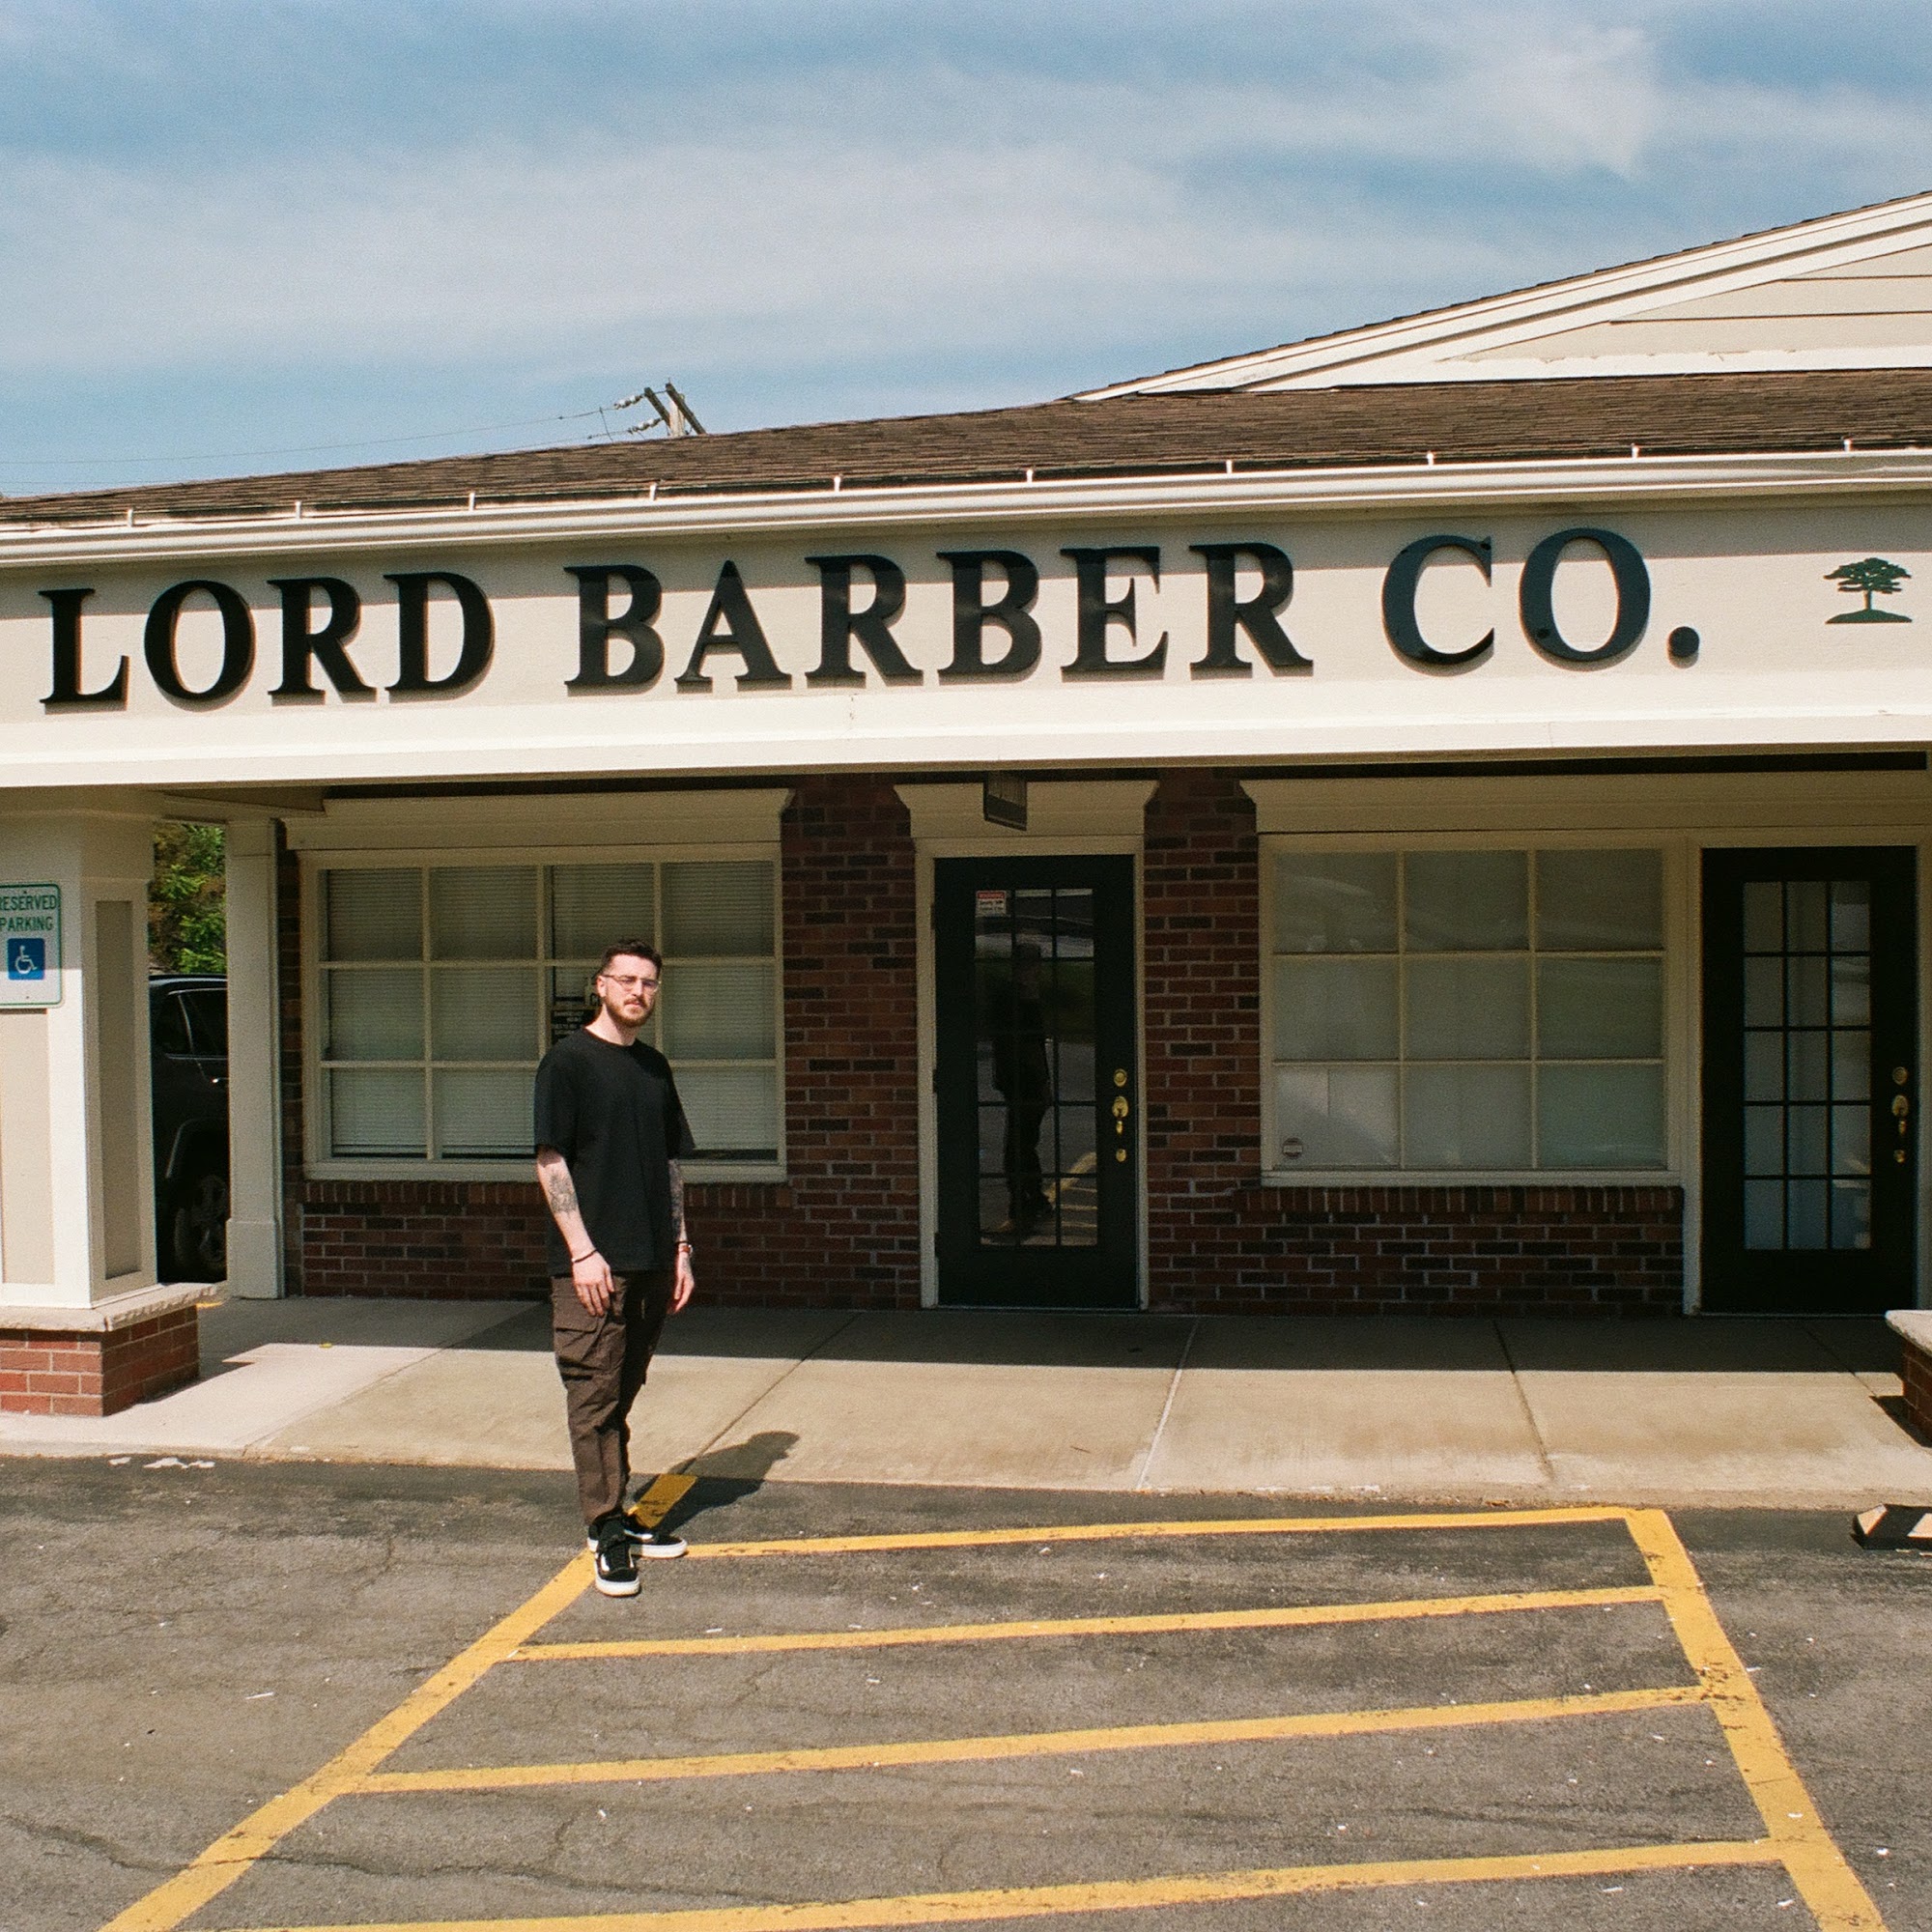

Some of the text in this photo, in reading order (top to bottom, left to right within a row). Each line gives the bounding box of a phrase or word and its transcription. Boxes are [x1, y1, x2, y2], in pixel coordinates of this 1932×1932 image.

[39, 527, 1699, 708] LORD BARBER CO.
[0, 917, 53, 931] PARKING
